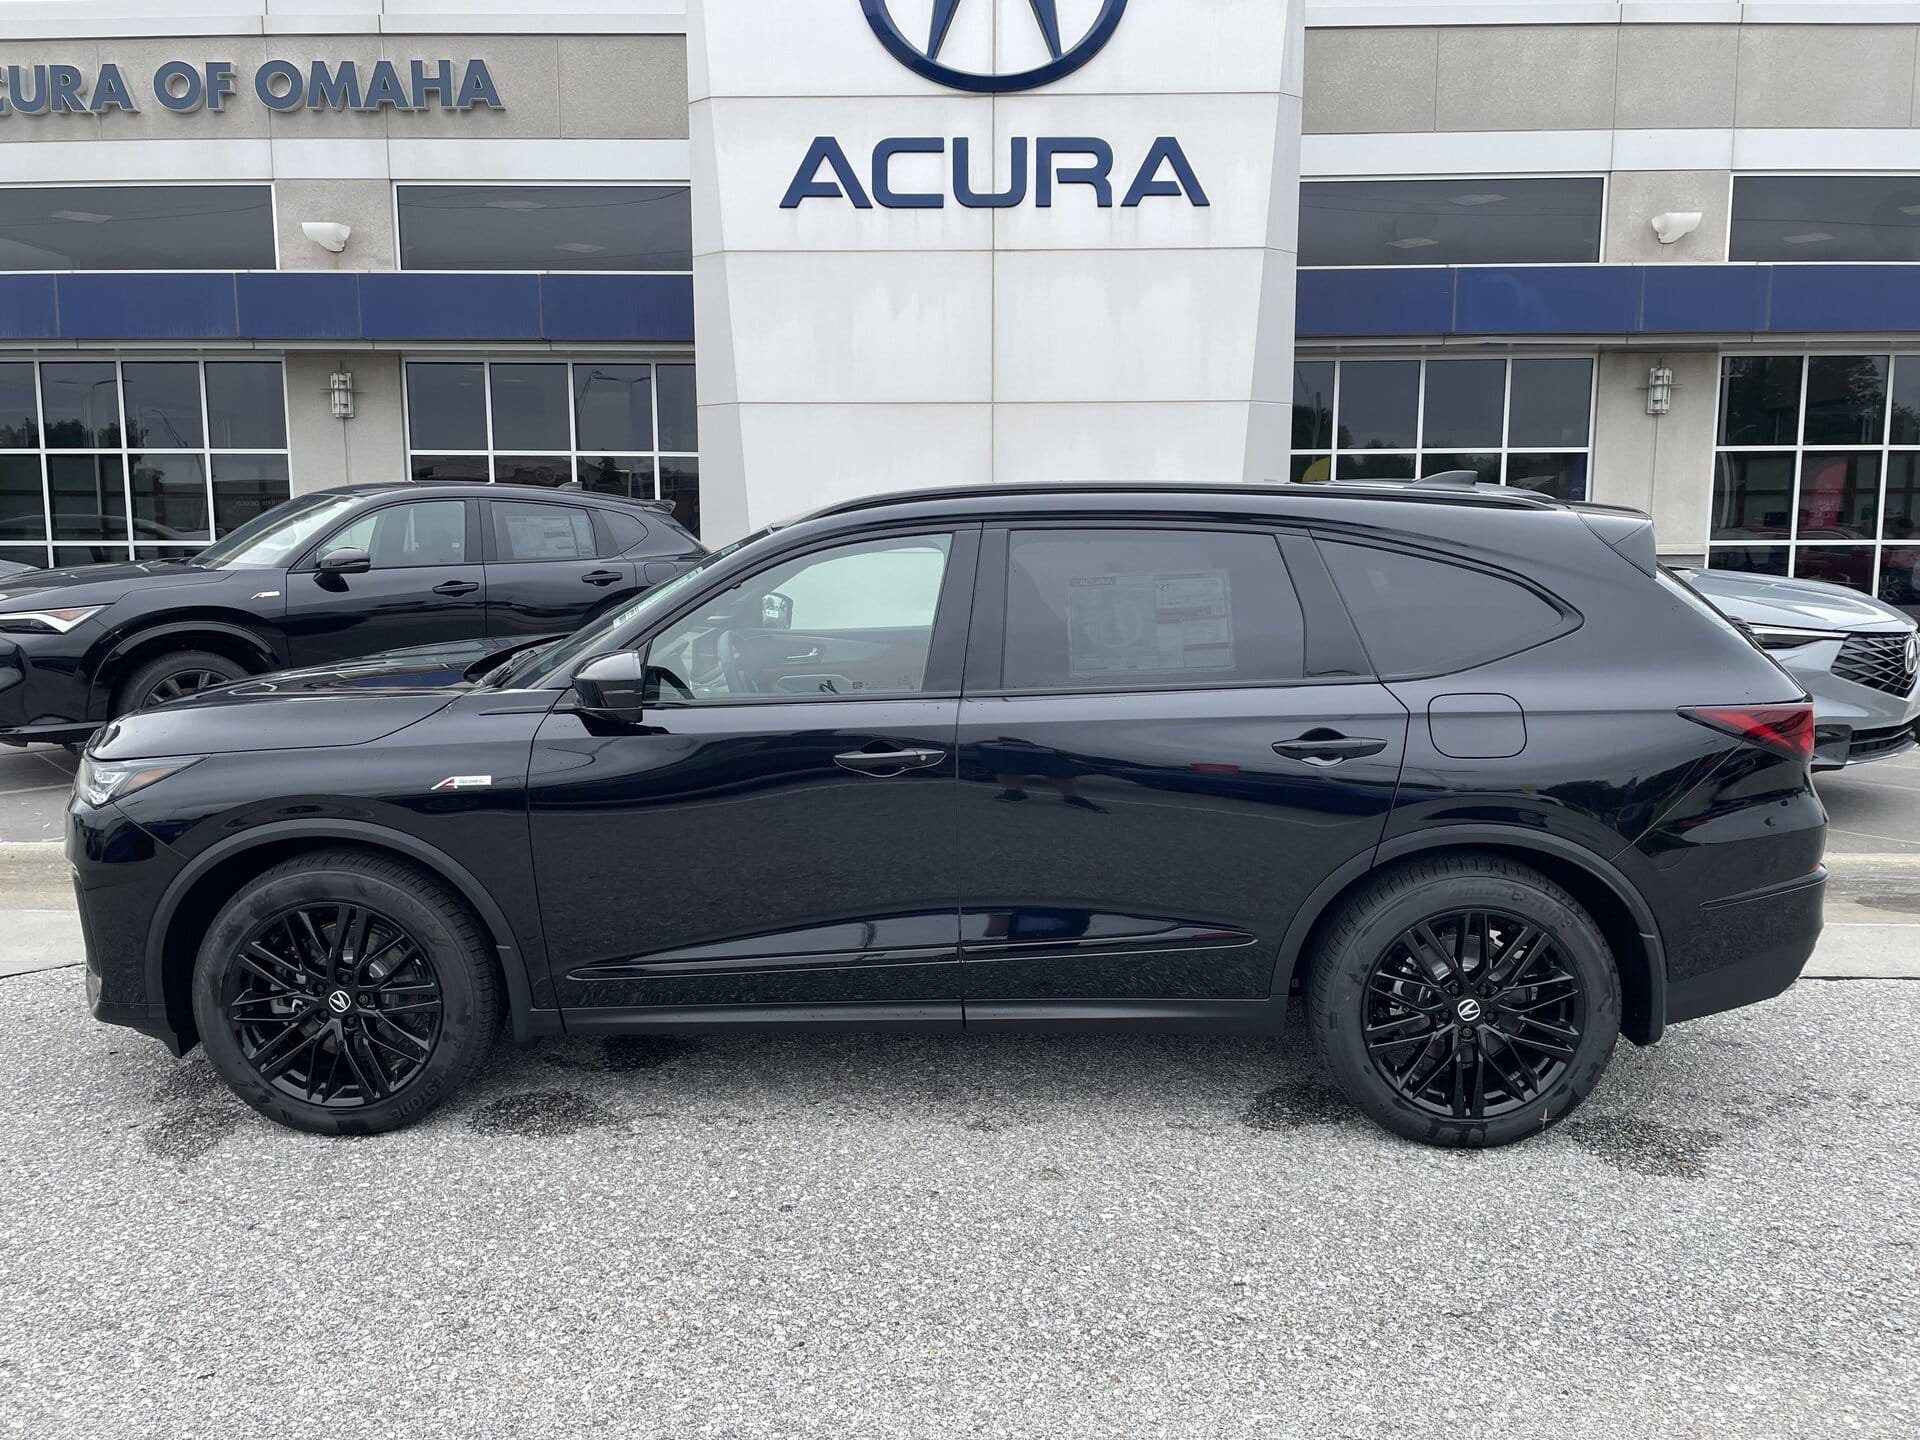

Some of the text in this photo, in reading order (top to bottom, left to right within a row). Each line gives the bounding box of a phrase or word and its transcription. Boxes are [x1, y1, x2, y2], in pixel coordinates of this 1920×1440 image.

[0, 59, 504, 115] URA OF OMAHA
[779, 136, 1210, 209] ACURA
